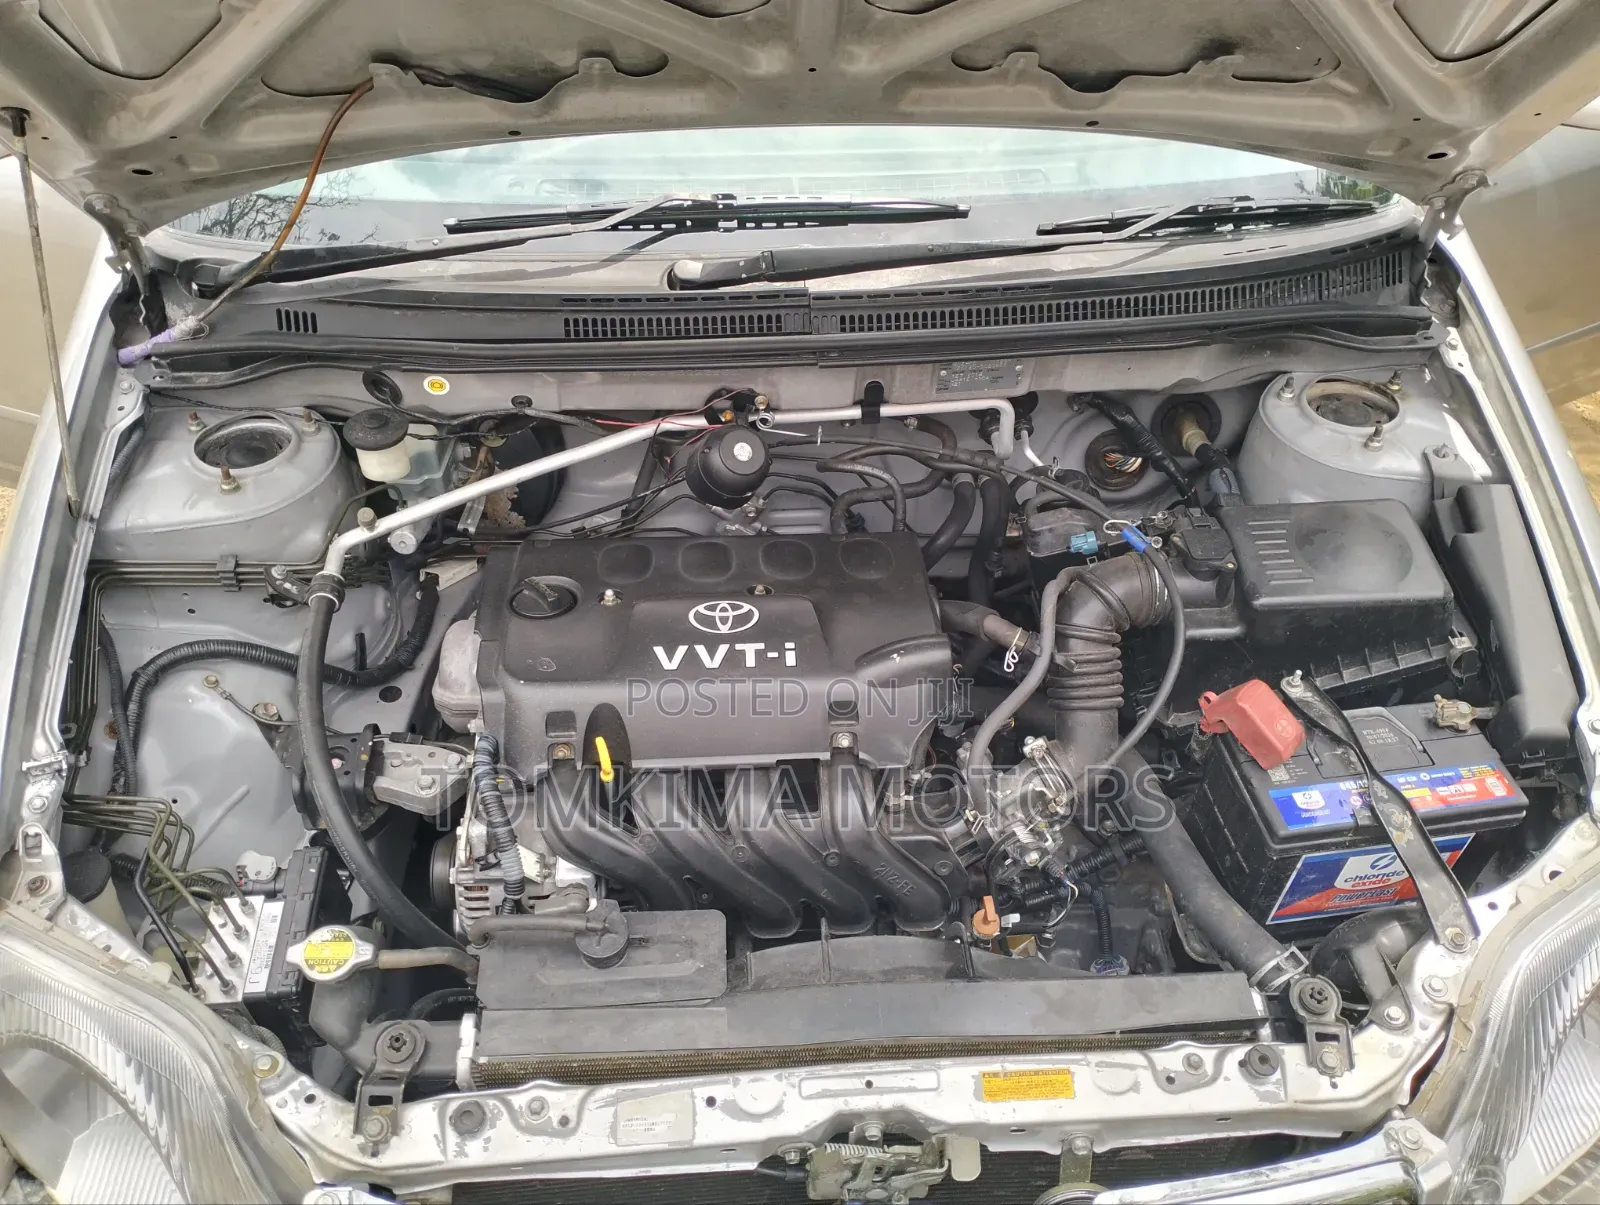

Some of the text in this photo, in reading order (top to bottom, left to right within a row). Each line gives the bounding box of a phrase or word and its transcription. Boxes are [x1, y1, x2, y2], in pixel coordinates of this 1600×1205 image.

[653, 642, 798, 670] VVT-i
[1344, 870, 1405, 883] chloride
[1351, 878, 1391, 888] exide
